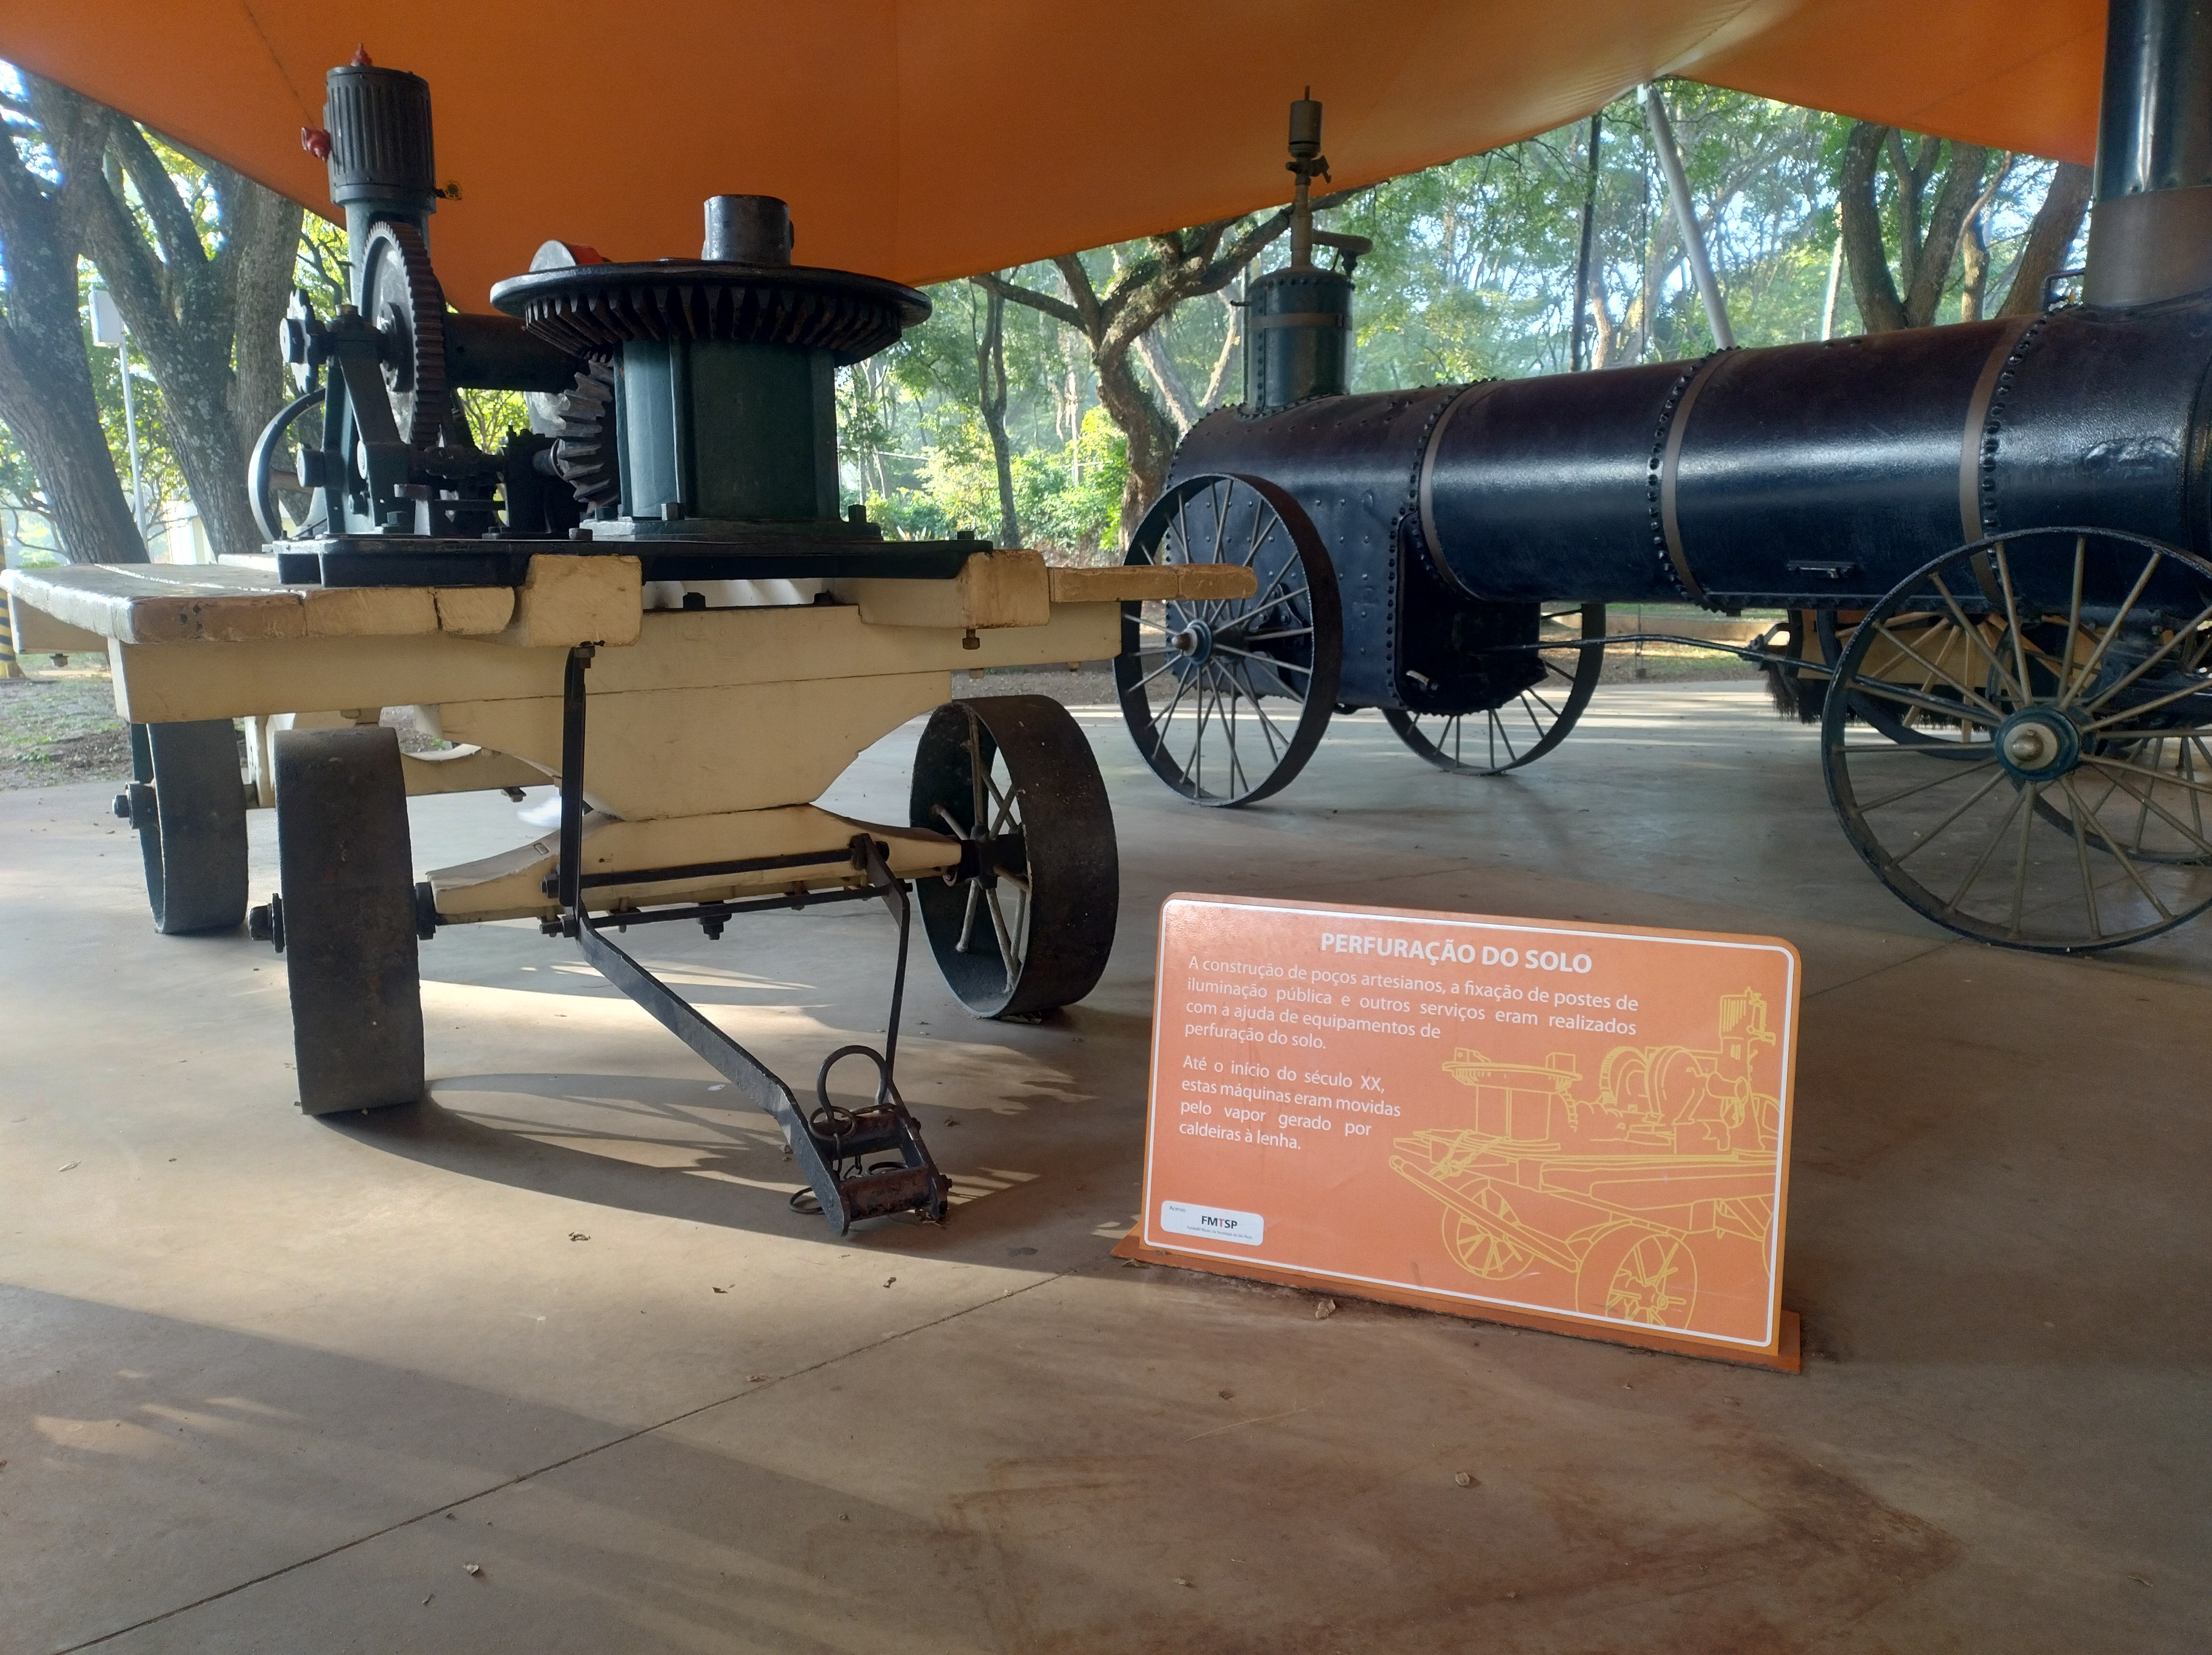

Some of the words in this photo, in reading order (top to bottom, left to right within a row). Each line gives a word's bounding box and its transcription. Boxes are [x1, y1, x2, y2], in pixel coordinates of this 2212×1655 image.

[1321, 933, 1475, 966] PERFURAÇÃO
[1481, 946, 1519, 967] DO
[1525, 950, 1592, 974] SOLO
[1188, 956, 1199, 970] A
[1203, 960, 1284, 979] construção
[1288, 965, 1307, 980] de
[1311, 970, 1357, 986] poços
[1361, 974, 1446, 995] artesianos,
[1450, 983, 1460, 994] a
[1464, 980, 1524, 1002] fixação
[1527, 986, 1549, 1003] de
[1554, 992, 1611, 1009] postes
[1616, 994, 1639, 1011] de
[1186, 1002, 1217, 1015] com
[1221, 1006, 1229, 1016] a
[1234, 1006, 1274, 1022] ajuda
[1280, 1008, 1299, 1023] de
[1302, 1014, 1415, 1036] equipamentos
[1420, 1022, 1441, 1039] de
[1188, 977, 1268, 1000] iluminação
[1276, 987, 1332, 1004] pública
[1341, 995, 1351, 1006] e
[1360, 997, 1410, 1012] outros
[1420, 1003, 1485, 1022] serviços
[1495, 1011, 1538, 1025] eram
[1549, 1014, 1637, 1035] realizados
[1185, 1022, 1264, 1044] perfuração
[1268, 1029, 1288, 1044] do
[1291, 1033, 1326, 1049] solo.
[1183, 1055, 1207, 1071] Até
[1214, 1062, 1224, 1073] o
[1231, 1060, 1270, 1078] início
[1277, 1065, 1297, 1081] do
[1304, 1070, 1352, 1088] século
[1360, 1075, 1385, 1094] XX,
[1181, 1080, 1217, 1094] estas
[1220, 1083, 1291, 1103] máquinas
[1294, 1093, 1332, 1108] eram
[1336, 1098, 1401, 1117] movidas
[1179, 1122, 1241, 1141] caldeiras
[1244, 1128, 1253, 1143] à
[1257, 1129, 1301, 1150] lenha.
[1180, 1100, 1212, 1115] pelo
[1224, 1107, 1266, 1123] vapor
[1278, 1114, 1331, 1131] gerado
[1345, 1122, 1372, 1137] por
[1201, 1216, 1238, 1229] FMTSP
